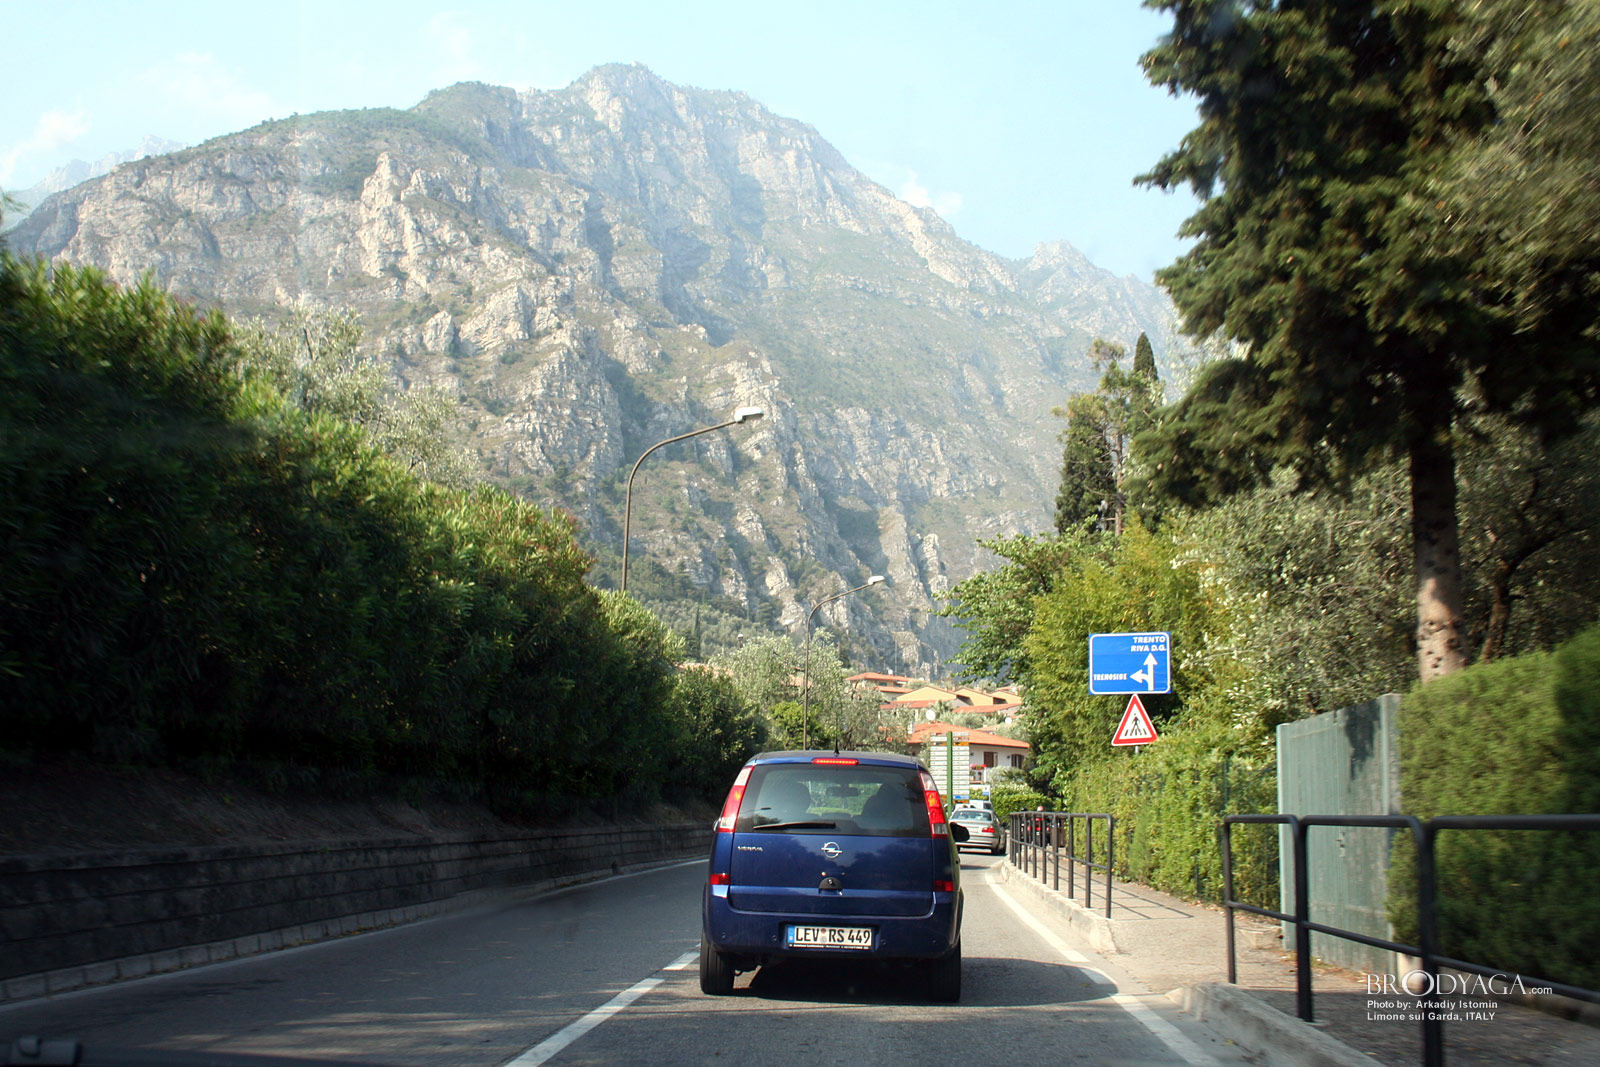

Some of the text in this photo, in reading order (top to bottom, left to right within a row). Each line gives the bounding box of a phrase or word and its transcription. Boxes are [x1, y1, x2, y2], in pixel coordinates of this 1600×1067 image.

[1151, 644, 1167, 652] D.G.
[796, 928, 870, 943] LEV RS 449
